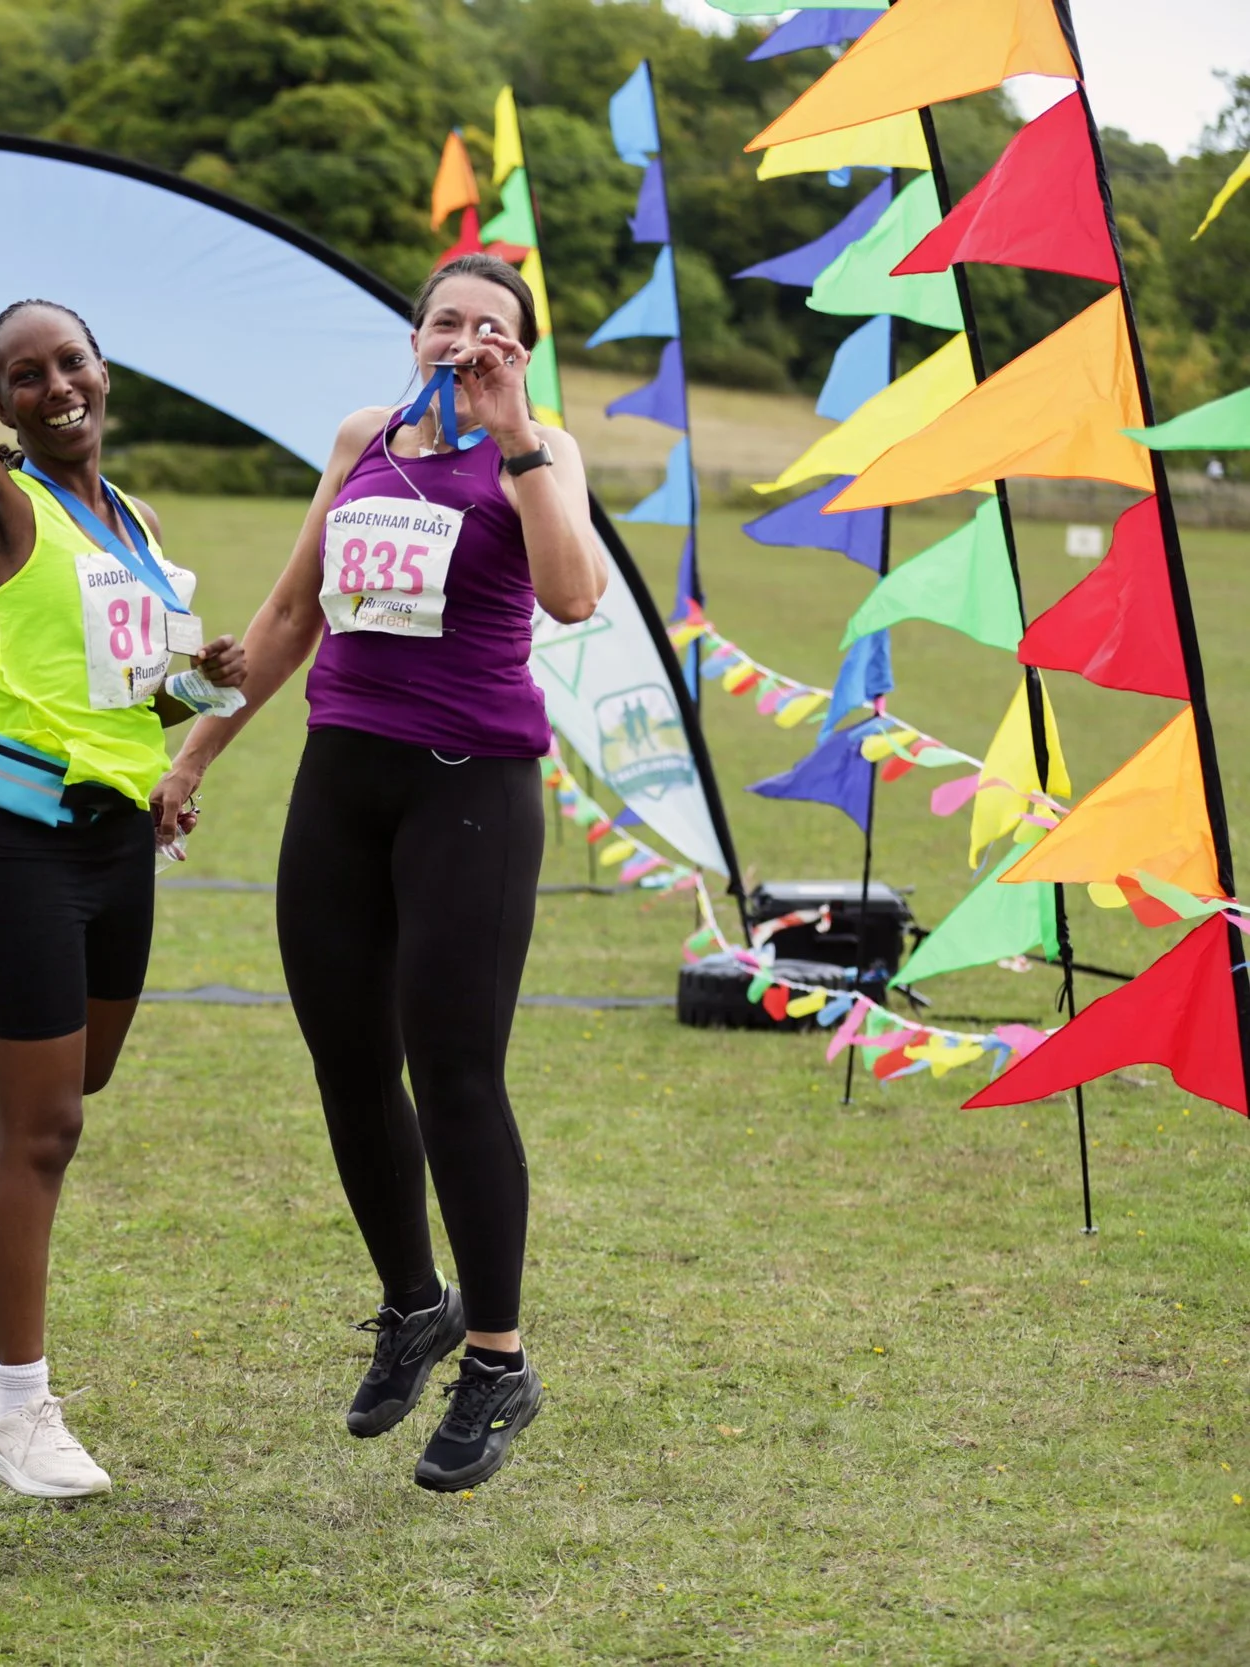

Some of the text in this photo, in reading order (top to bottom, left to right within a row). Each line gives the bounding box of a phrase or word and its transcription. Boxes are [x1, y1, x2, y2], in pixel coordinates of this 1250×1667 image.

[334, 510, 452, 538] BRADENHAM BLAST
[338, 538, 430, 595] 835
